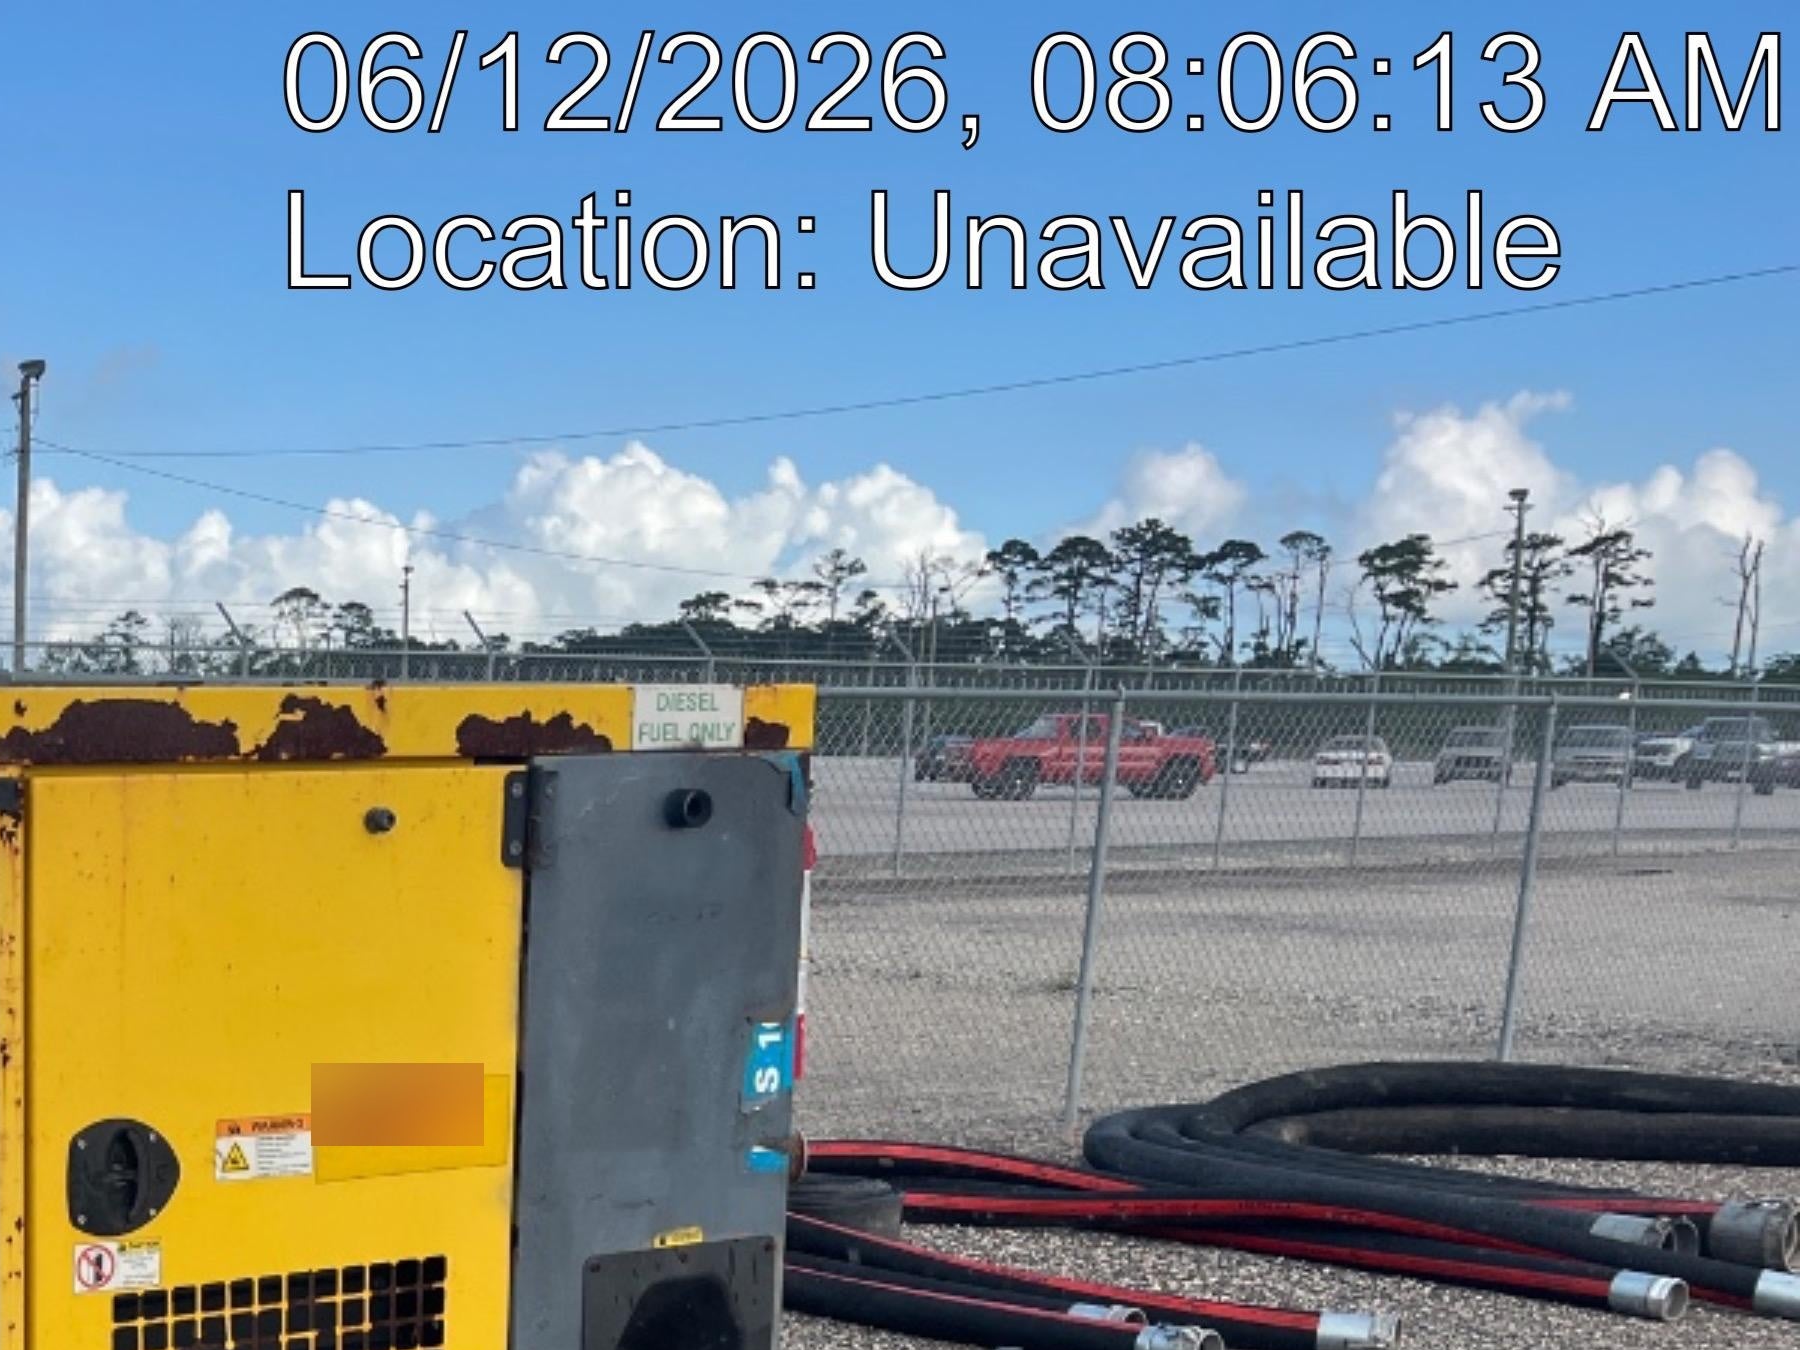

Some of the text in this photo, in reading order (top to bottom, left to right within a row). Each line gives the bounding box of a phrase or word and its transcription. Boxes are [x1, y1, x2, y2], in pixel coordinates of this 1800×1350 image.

[656, 692, 719, 712] DIESEL
[639, 722, 736, 743] FUEL ONLY
